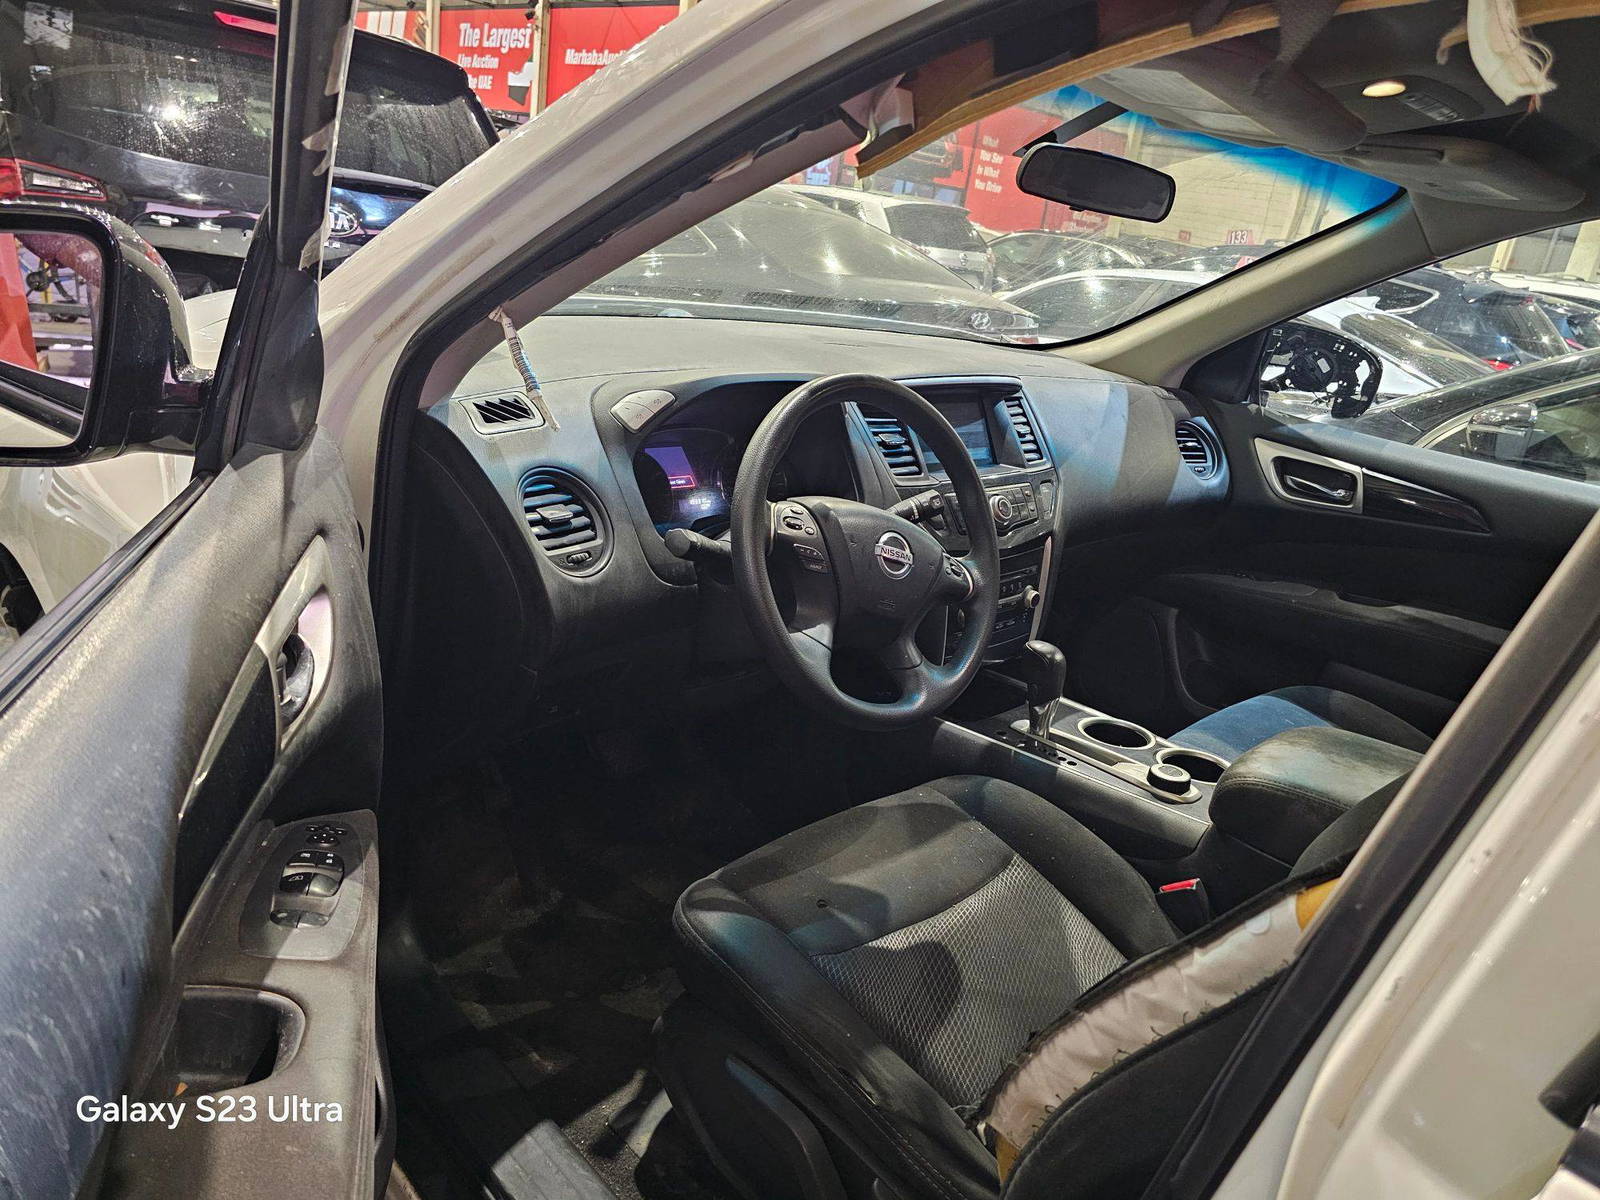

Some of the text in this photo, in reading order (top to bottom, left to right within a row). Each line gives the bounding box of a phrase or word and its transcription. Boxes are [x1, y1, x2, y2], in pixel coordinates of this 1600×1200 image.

[459, 23, 532, 53] The Largest
[472, 54, 499, 69] Auction
[478, 75, 493, 89] UAE
[980, 149, 991, 162] You
[975, 178, 986, 190] You
[1231, 230, 1248, 244] 133
[880, 547, 912, 561] NISSAN
